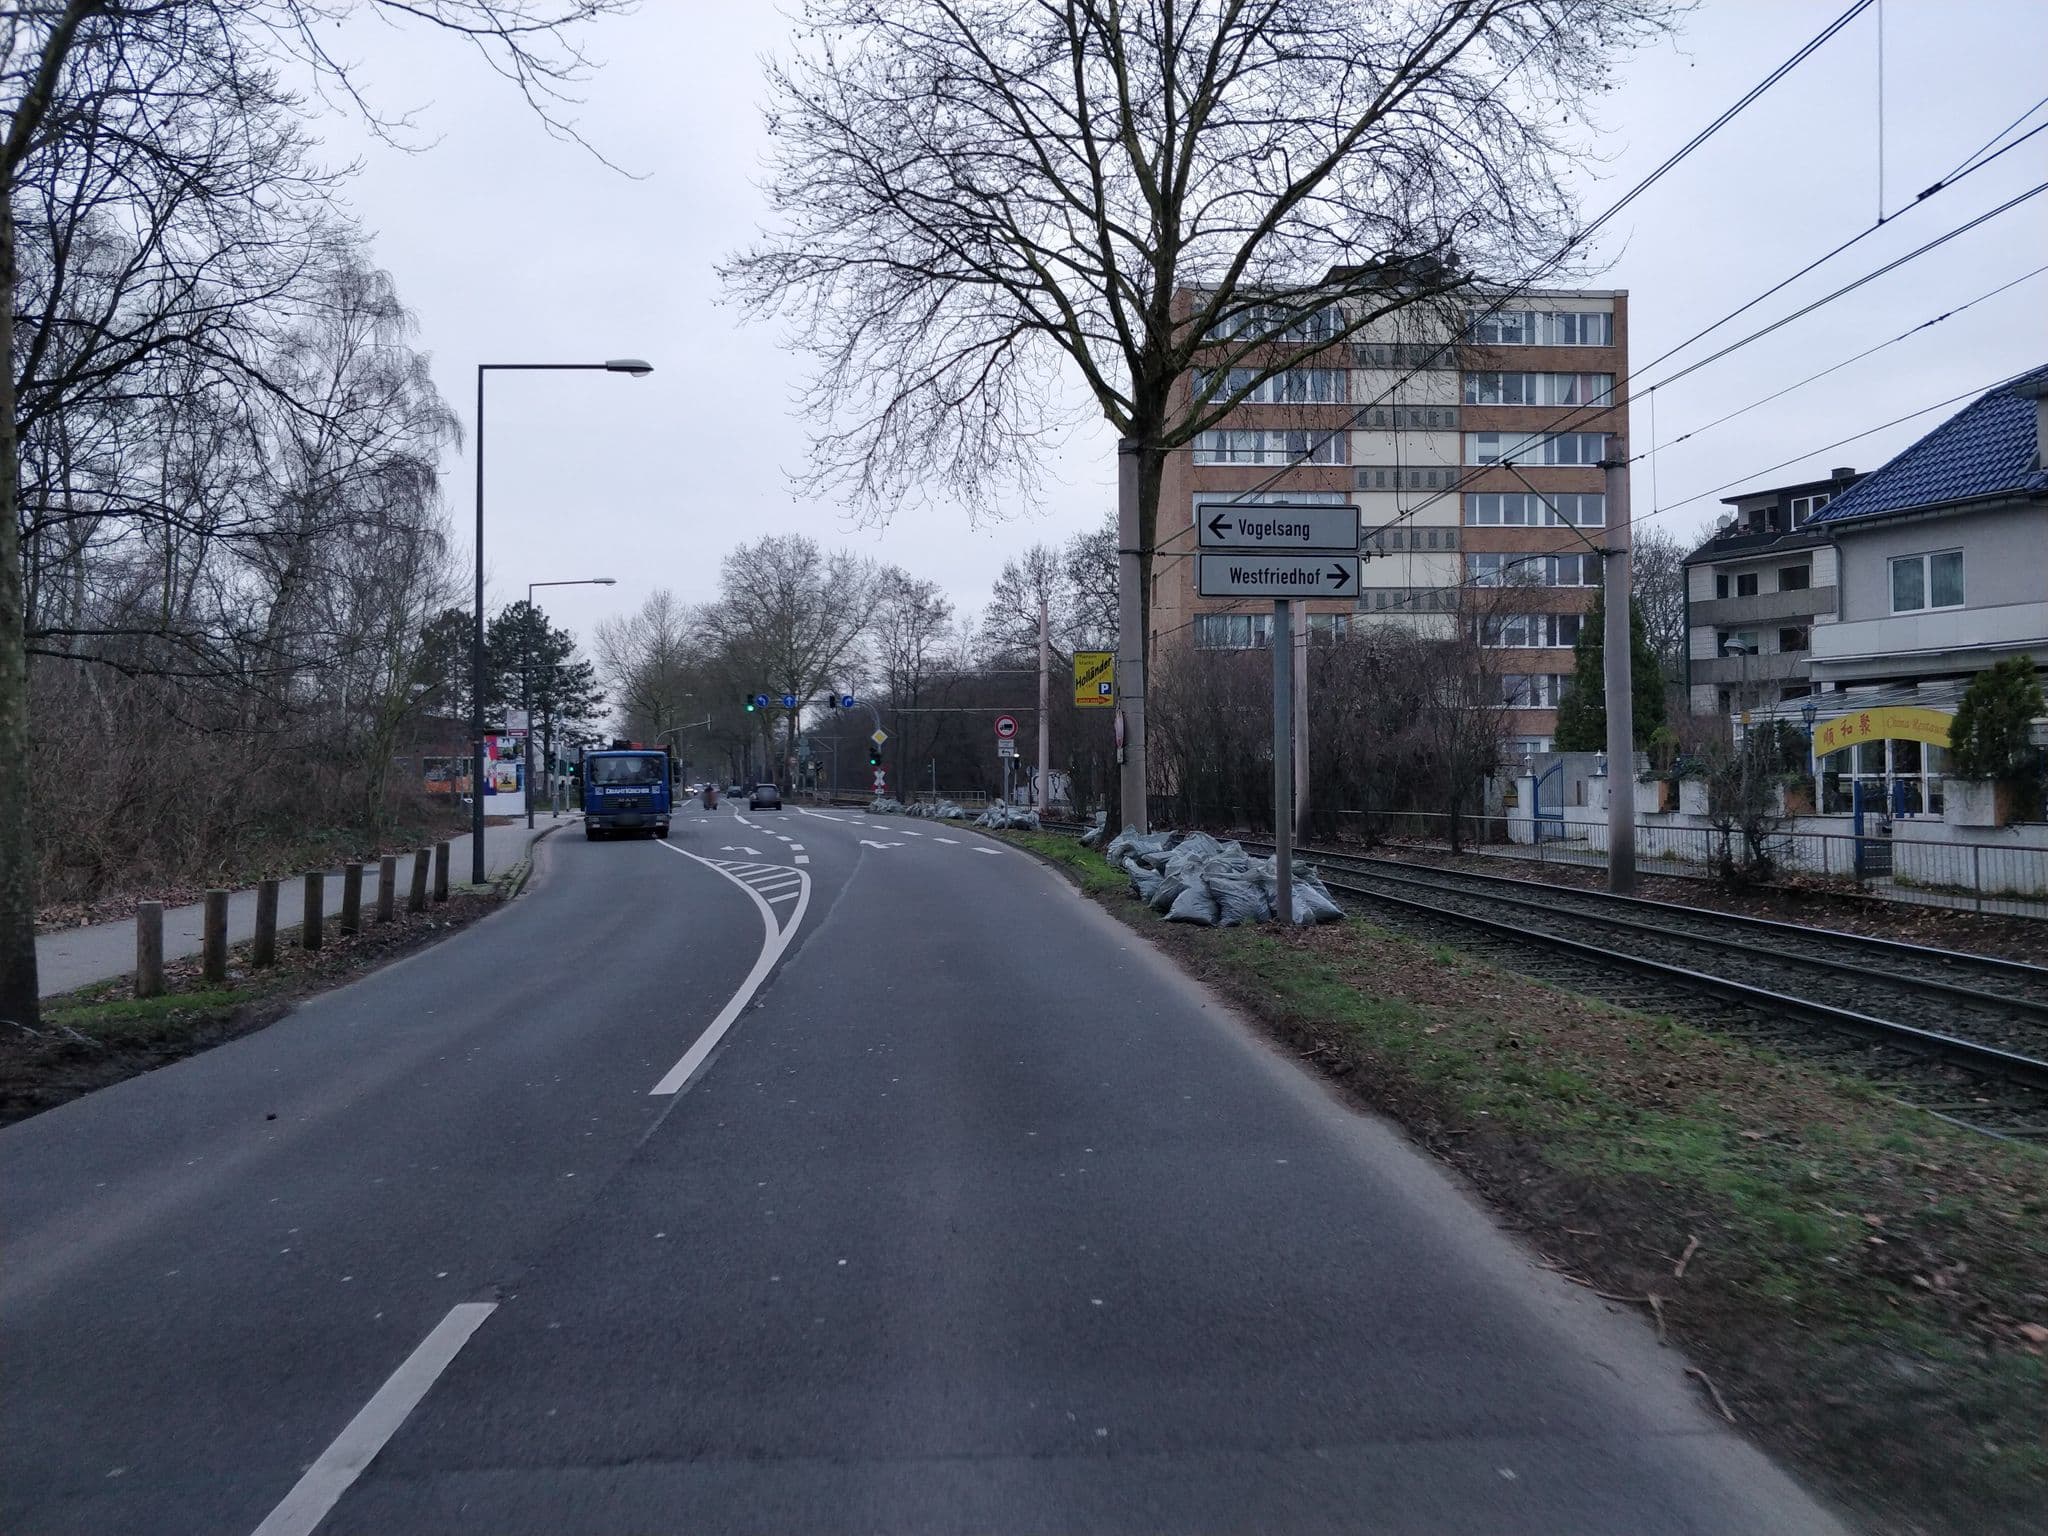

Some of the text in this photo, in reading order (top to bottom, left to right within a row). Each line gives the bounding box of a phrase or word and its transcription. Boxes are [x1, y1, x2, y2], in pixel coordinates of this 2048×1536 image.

[1238, 518, 1311, 541] Vogelsang
[1229, 567, 1321, 585] Westfriedhof
[1075, 657, 1112, 690] Holländer
[1100, 683, 1110, 694] P
